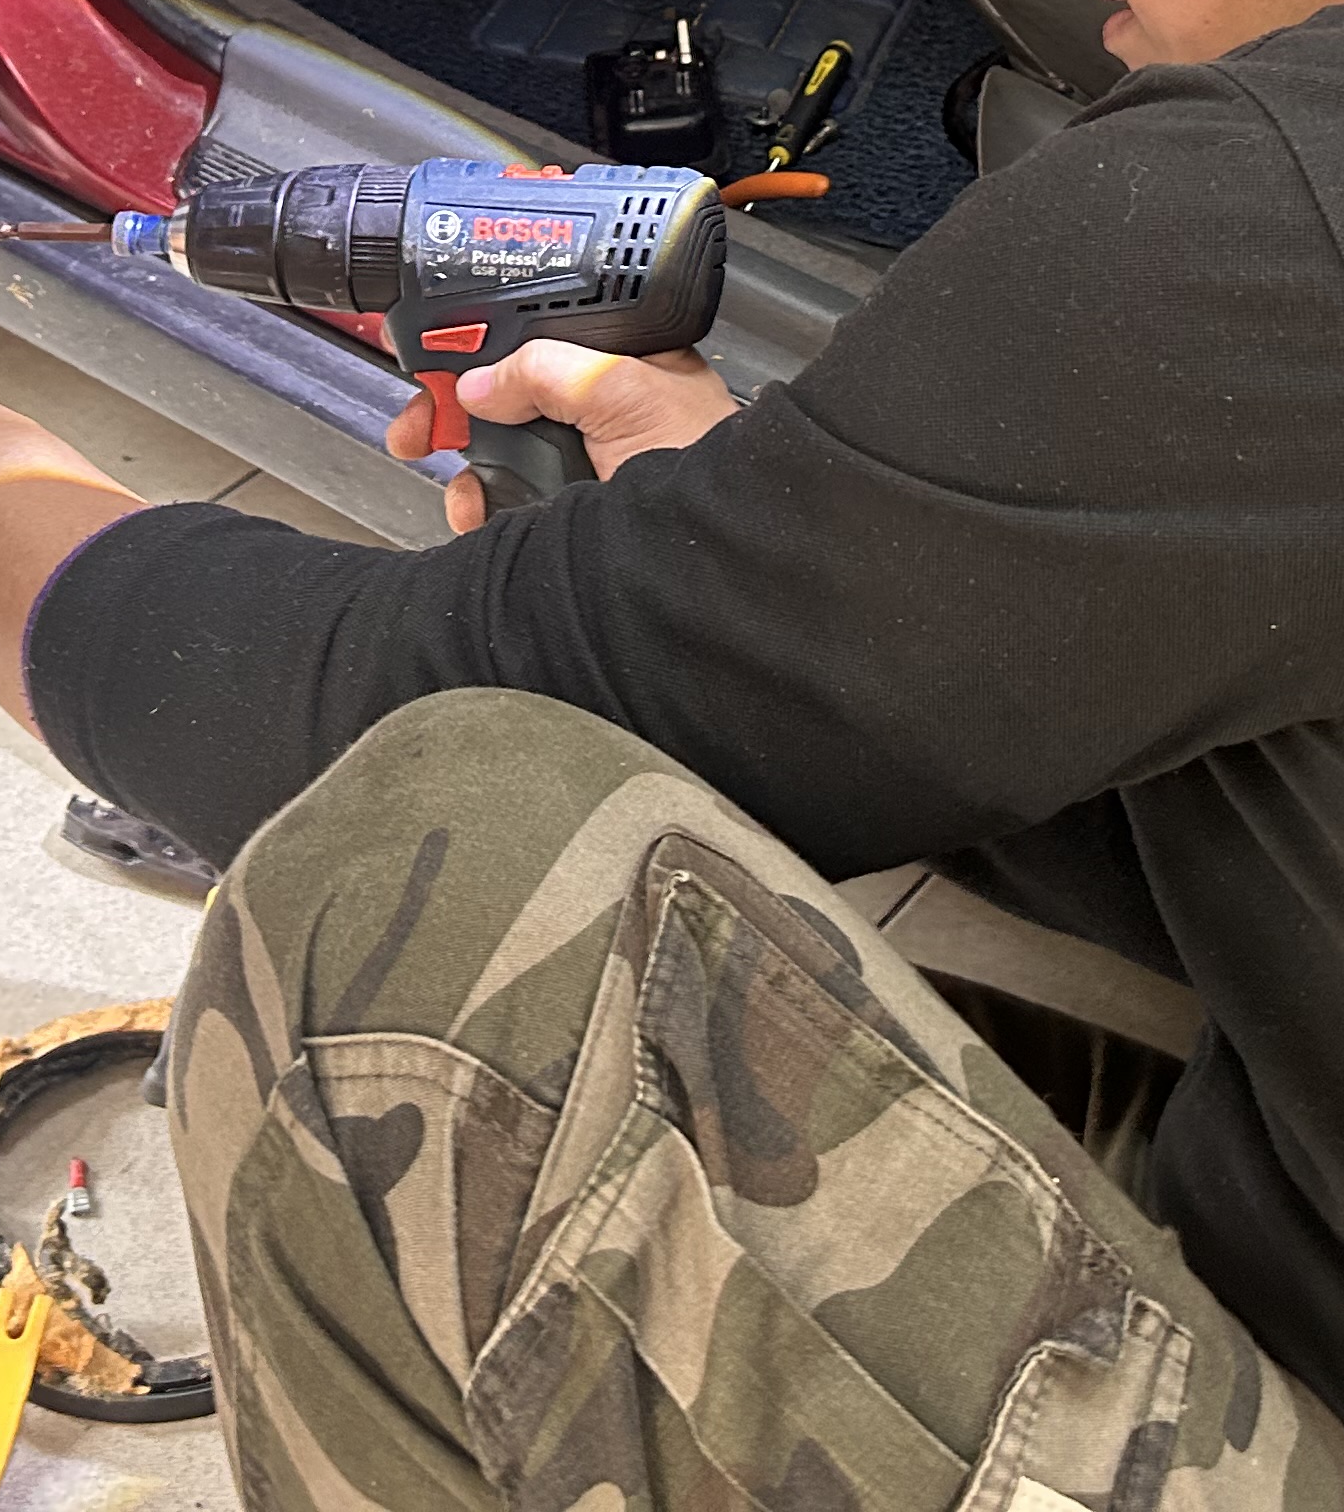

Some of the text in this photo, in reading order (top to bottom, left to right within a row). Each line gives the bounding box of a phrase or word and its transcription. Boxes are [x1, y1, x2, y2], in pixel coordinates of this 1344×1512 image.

[473, 217, 573, 244] BOSCH
[472, 250, 571, 267] Professinal
[471, 266, 497, 277] GSB
